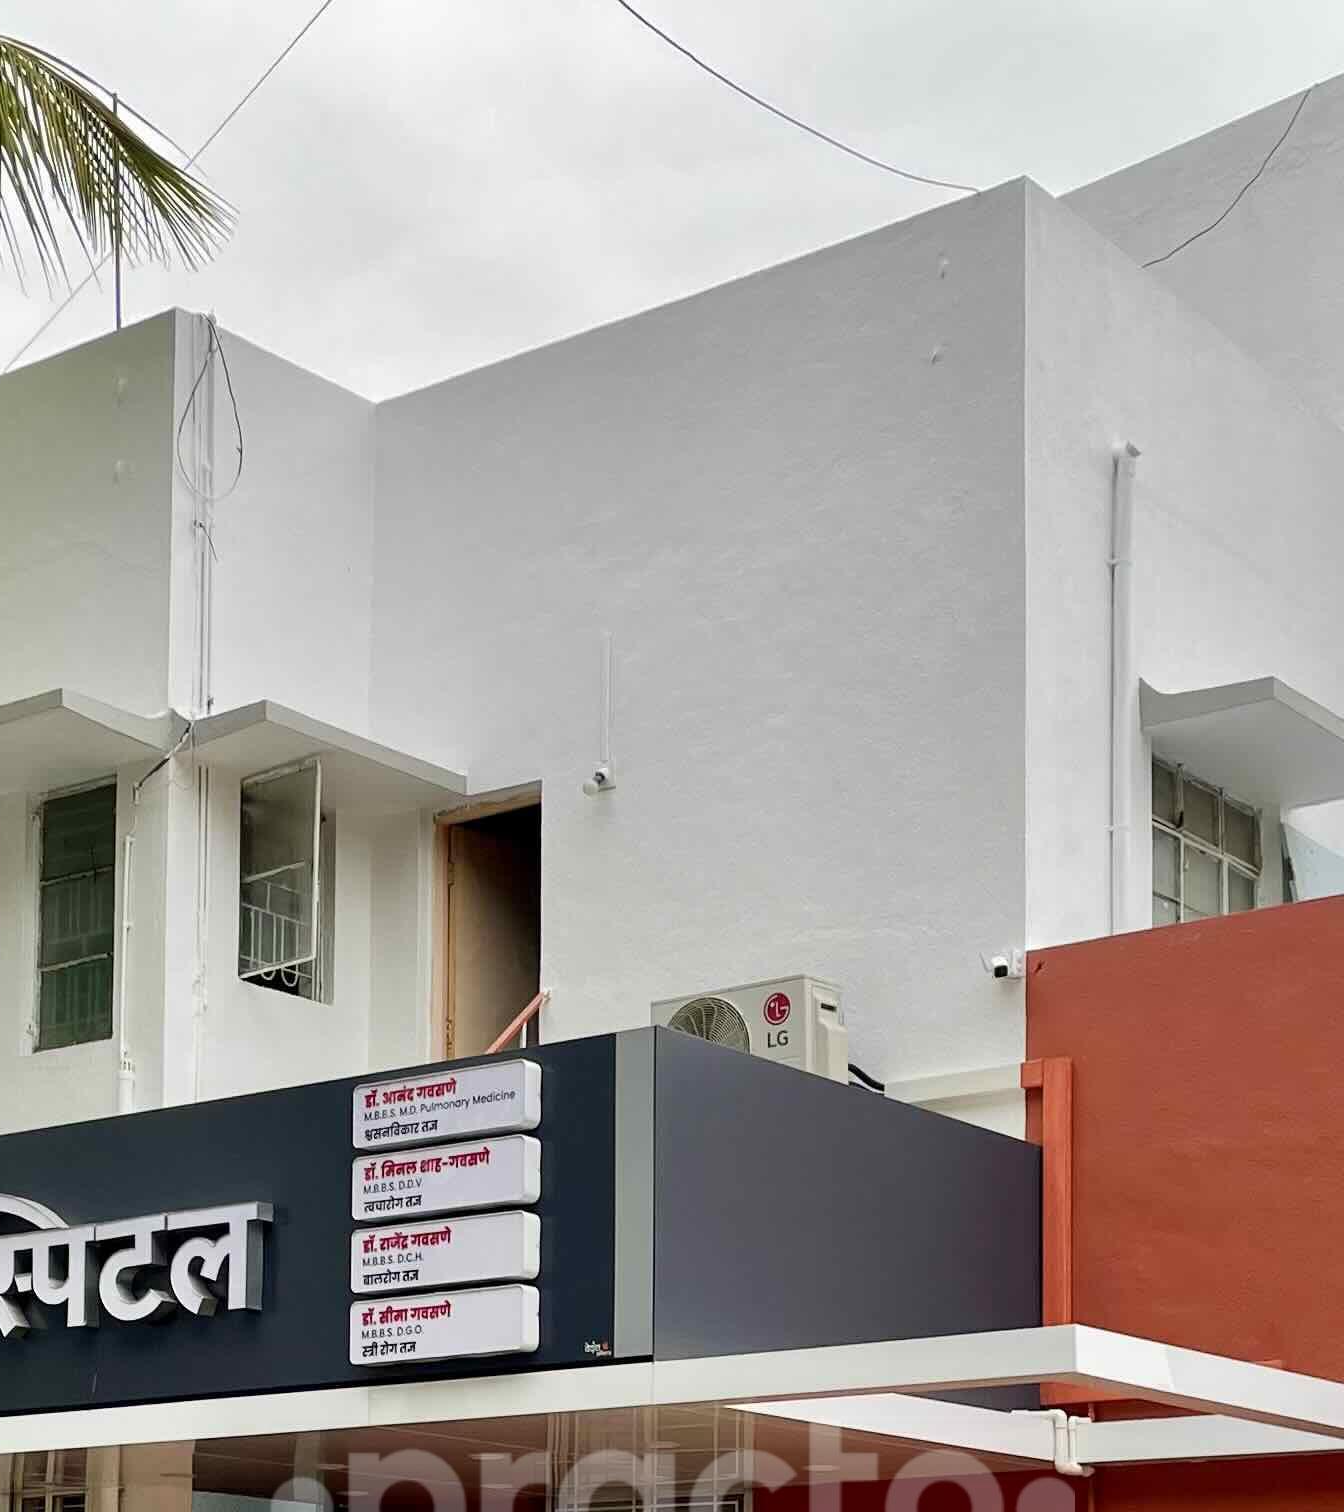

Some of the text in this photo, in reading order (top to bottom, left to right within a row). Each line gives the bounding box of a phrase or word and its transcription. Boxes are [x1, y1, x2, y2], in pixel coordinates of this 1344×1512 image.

[767, 1030, 789, 1049] LG
[382, 1085, 414, 1105] आनंद
[416, 1078, 457, 1099] गवसणे
[420, 1098, 470, 1112] Pulmonary
[472, 1090, 516, 1104] Medicine
[381, 1160, 417, 1179] मिनल
[410, 1226, 452, 1248] गवसणे
[379, 1306, 407, 1324] सीमा
[410, 1300, 452, 1321] गवसणे
[380, 1341, 398, 1355] रोग
